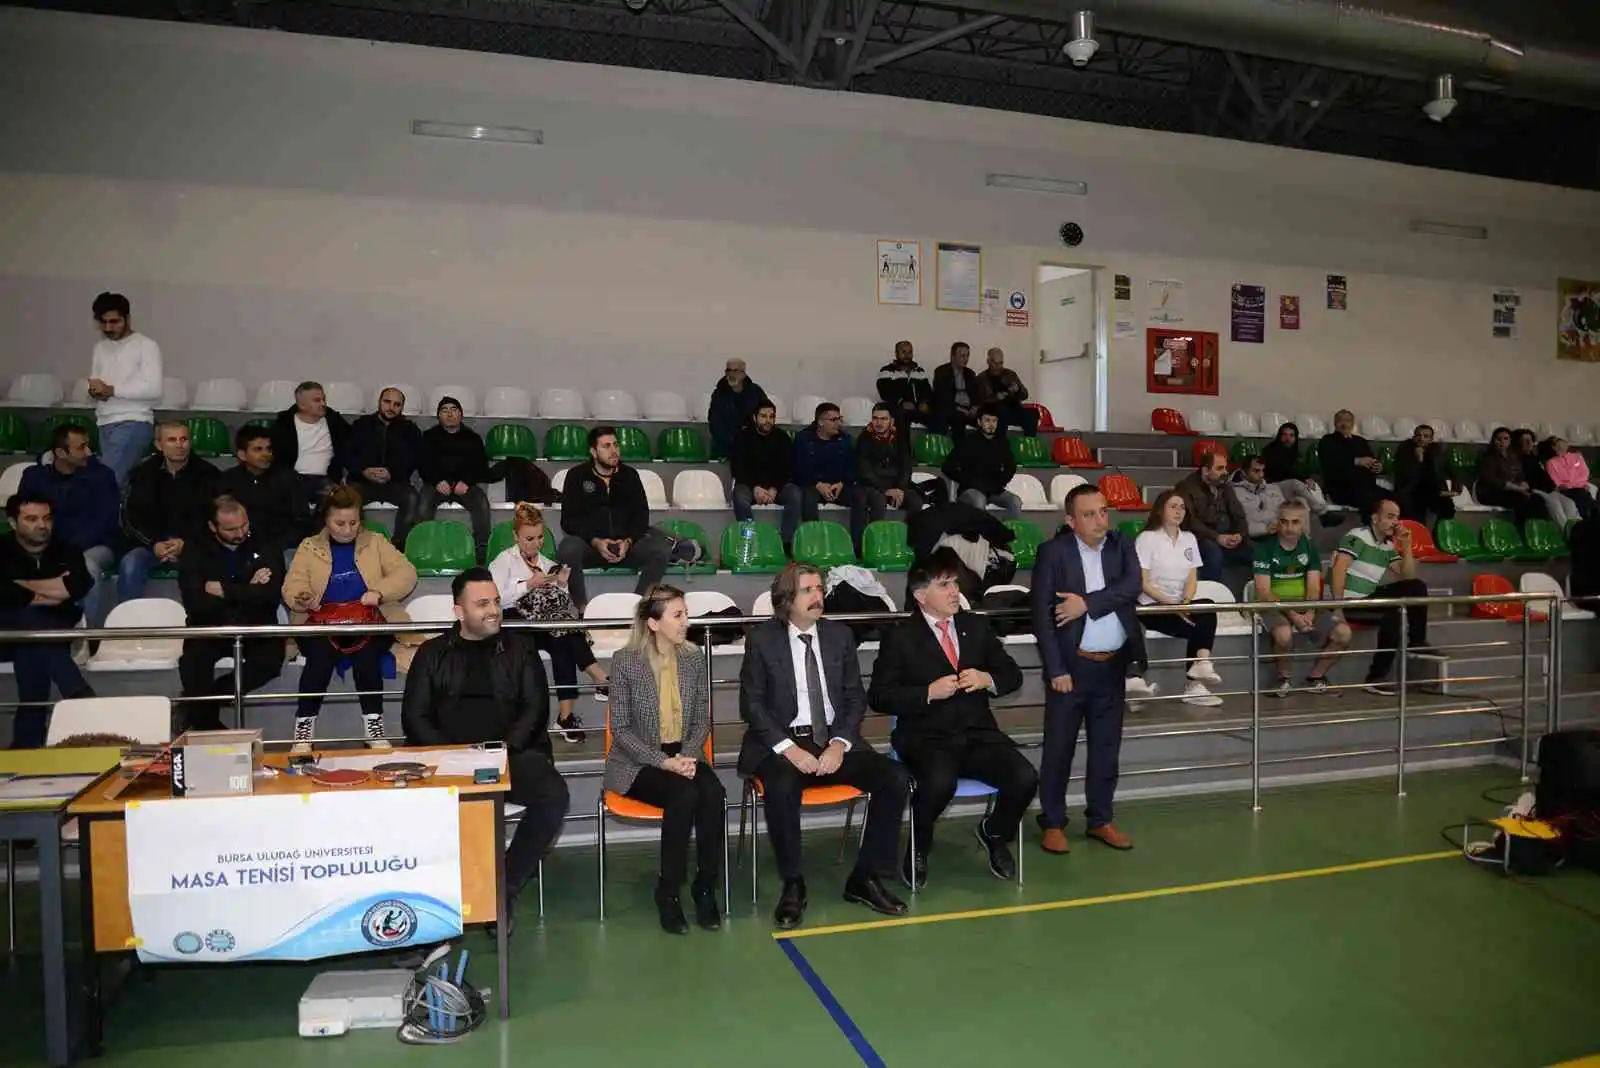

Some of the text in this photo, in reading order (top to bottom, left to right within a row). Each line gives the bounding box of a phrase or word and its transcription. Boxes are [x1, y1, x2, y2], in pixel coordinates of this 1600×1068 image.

[173, 753, 183, 789] STIGA
[171, 855, 418, 889] MASA TENİSİ TOPLULUĞU
[217, 853, 254, 864] BURSA
[256, 848, 301, 861] ULUDAĞ
